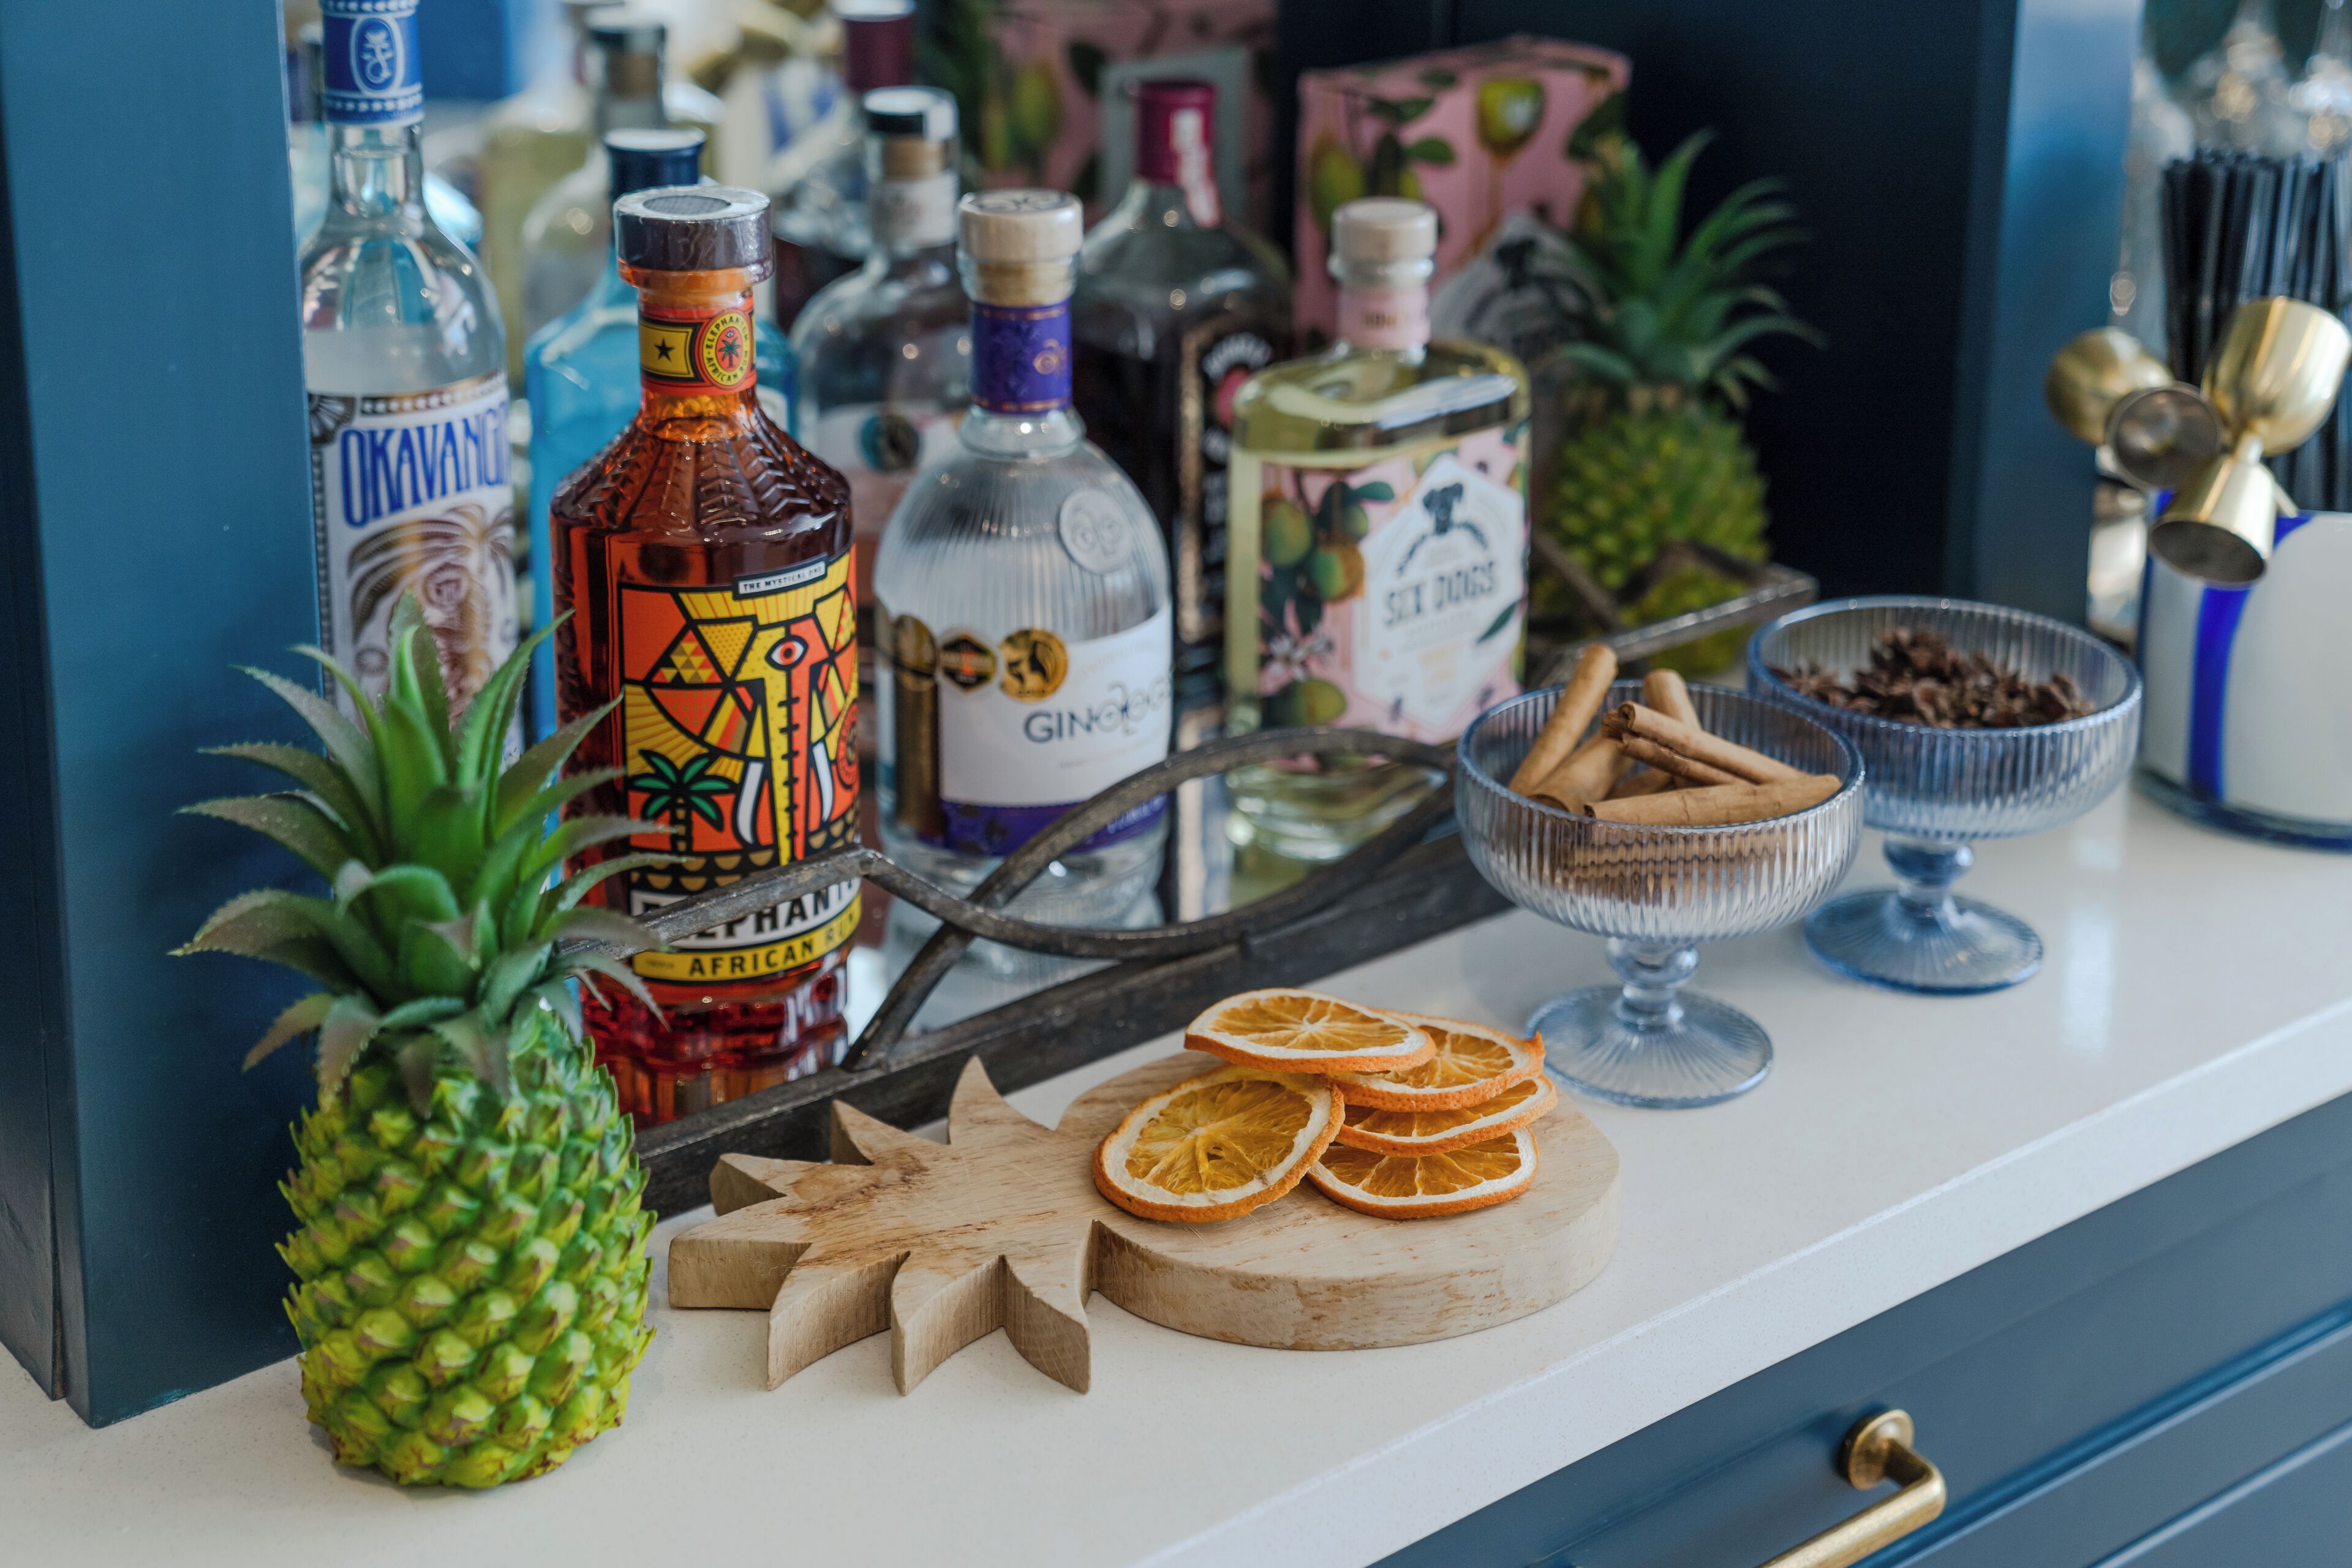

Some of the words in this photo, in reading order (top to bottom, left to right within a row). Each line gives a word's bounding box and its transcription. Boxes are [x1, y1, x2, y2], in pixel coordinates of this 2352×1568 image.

[706, 357, 738, 381] AFRICAN
[743, 582, 760, 591] THE
[764, 574, 805, 587] MYSTICAL
[688, 938, 815, 977] AFRICAN
